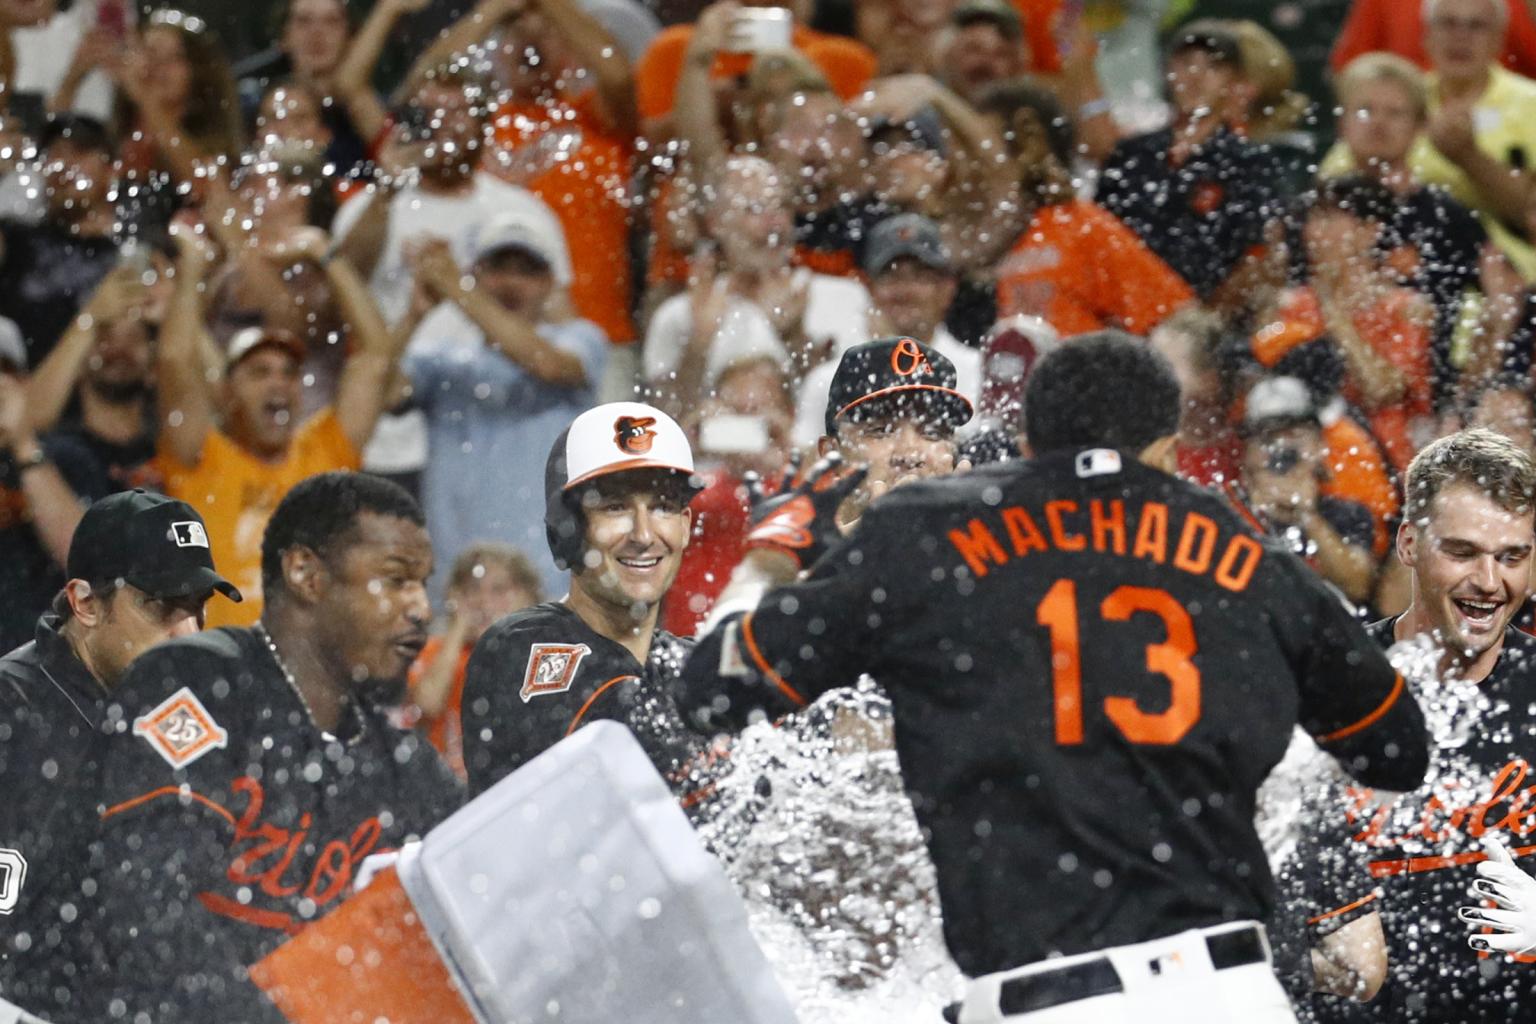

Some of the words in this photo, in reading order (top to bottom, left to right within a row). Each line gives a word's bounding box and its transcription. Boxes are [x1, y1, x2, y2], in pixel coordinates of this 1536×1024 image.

[947, 499, 1263, 592] MACHADO
[1036, 578, 1201, 745] 13
[164, 718, 199, 743] 25
